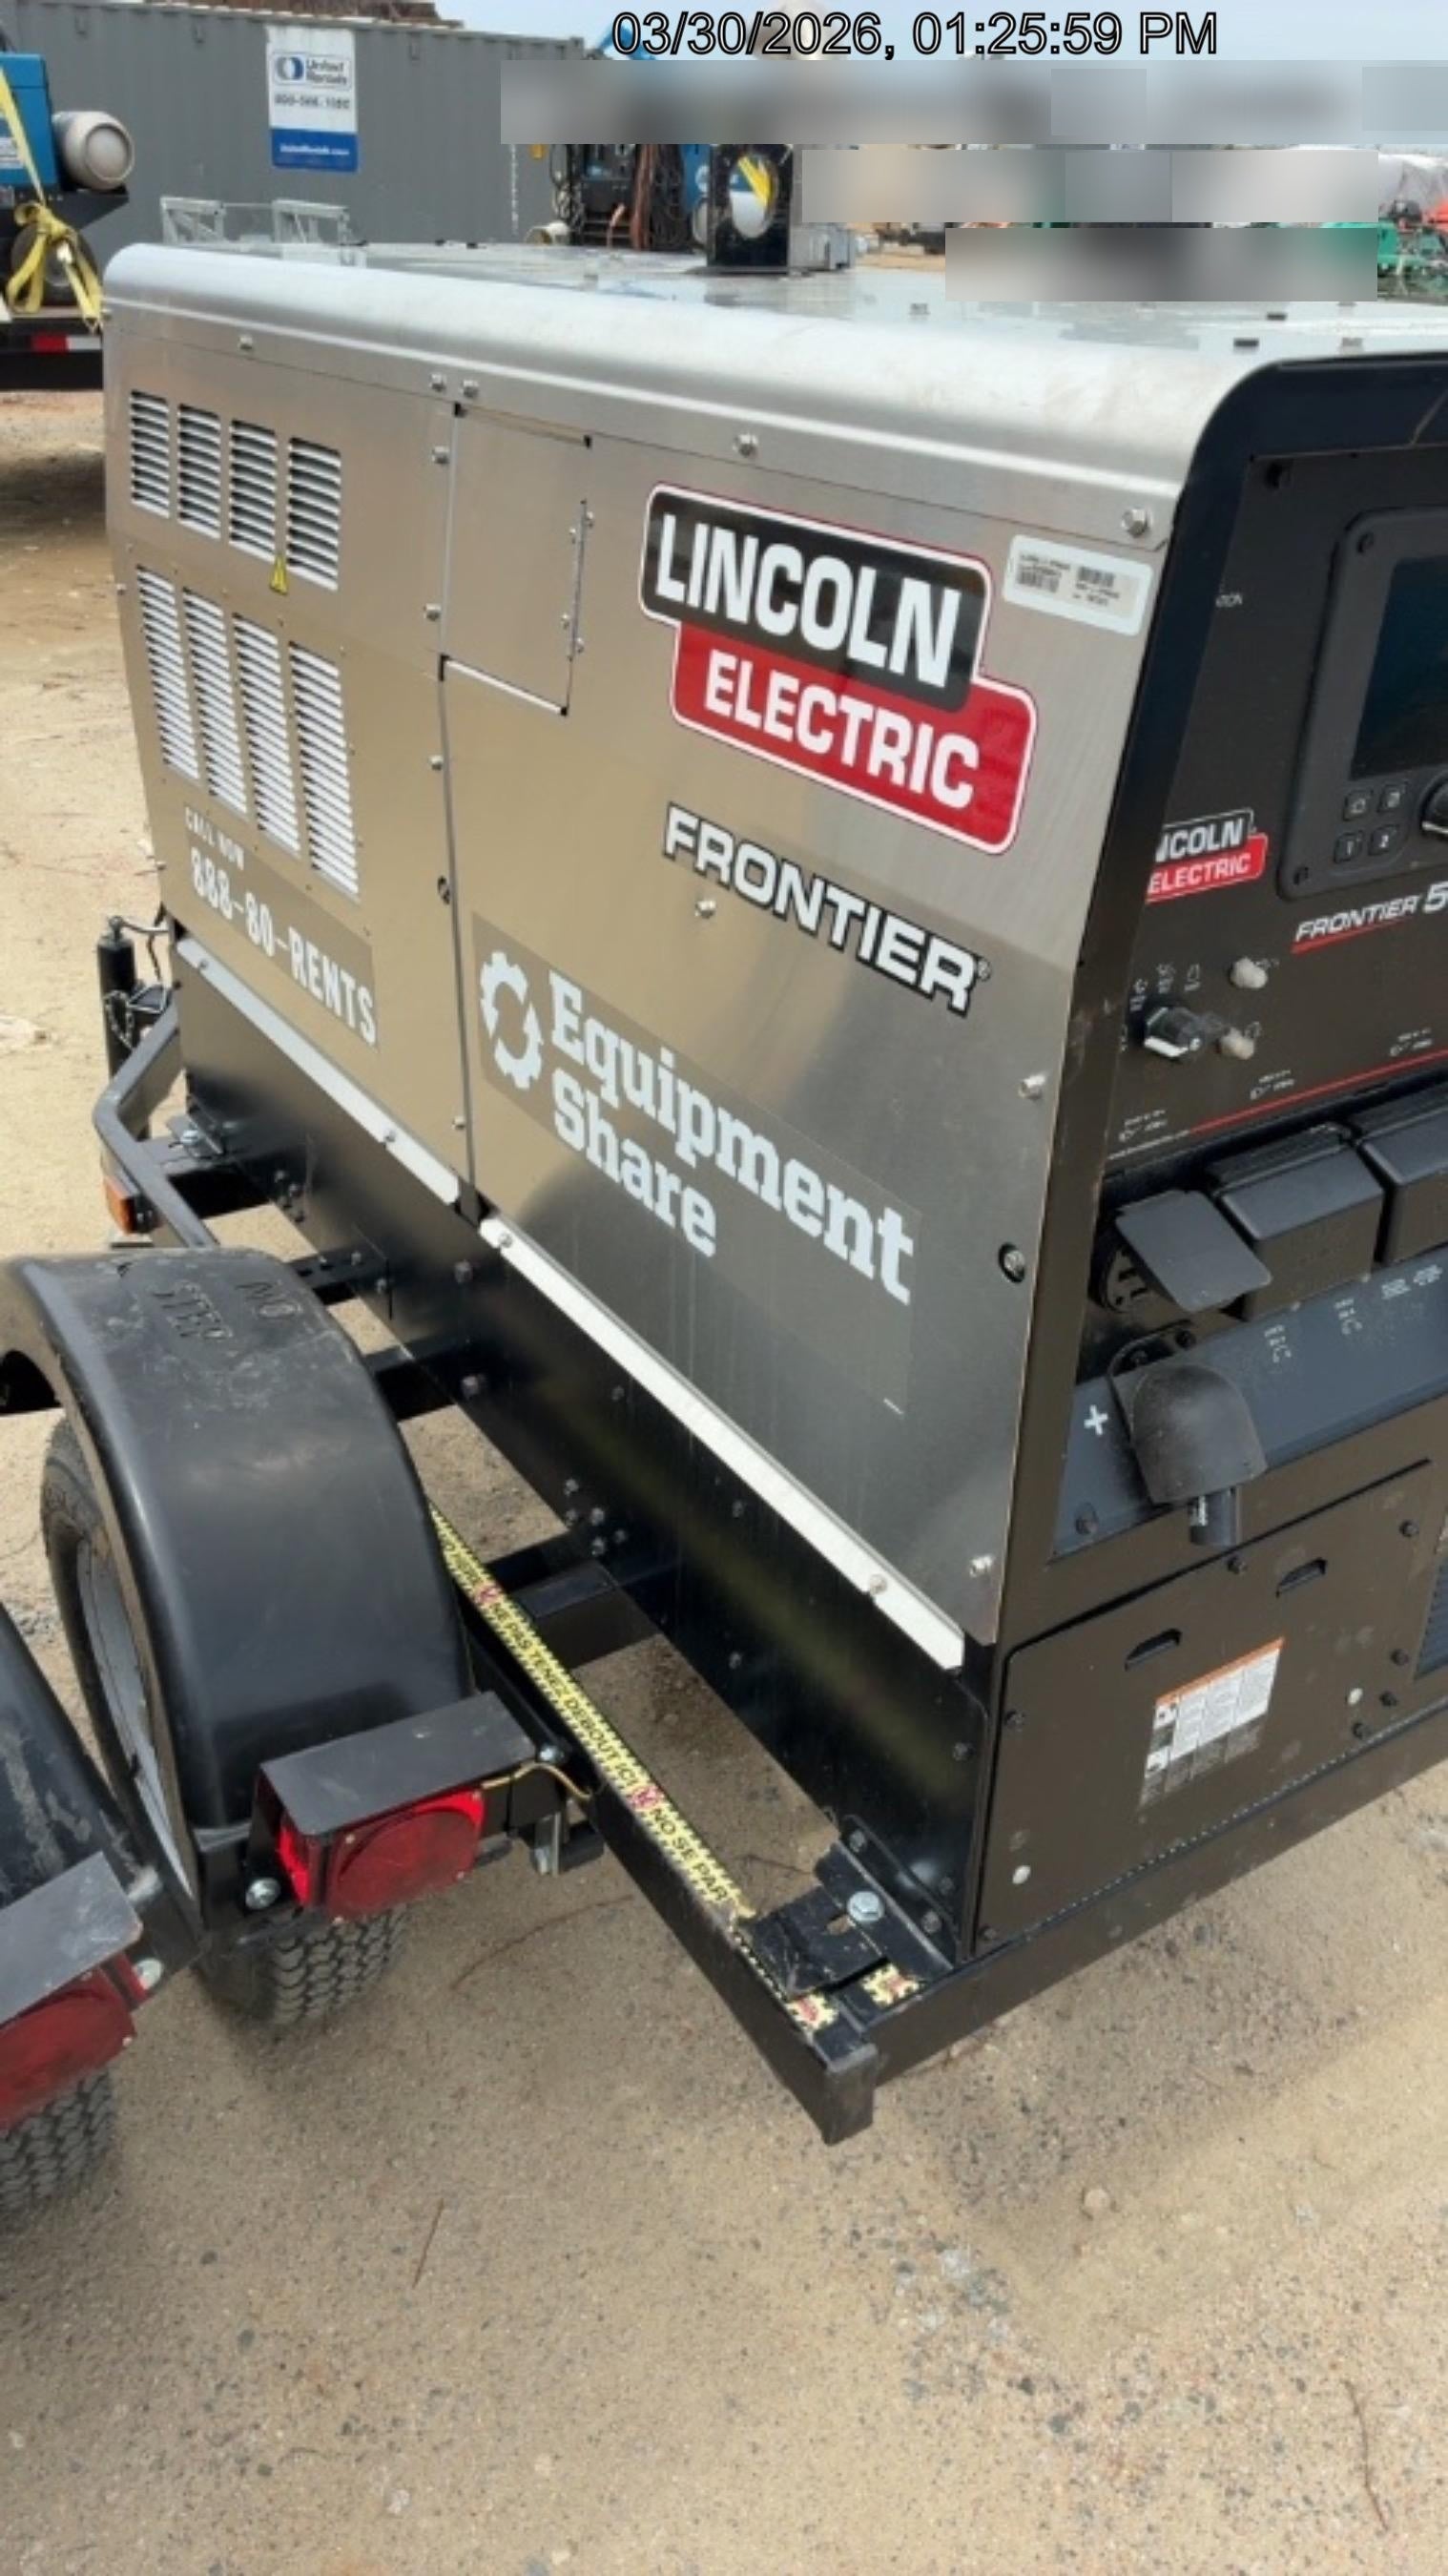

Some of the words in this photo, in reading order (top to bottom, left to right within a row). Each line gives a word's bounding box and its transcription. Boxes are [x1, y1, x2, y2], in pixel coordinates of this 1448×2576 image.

[654, 512, 962, 689] LINCOLN
[703, 648, 980, 809] ELECTRIC
[191, 845, 378, 1046] 888-80-RENTS
[1147, 852, 1252, 895] ELECTRIC
[1294, 893, 1420, 943] FRONTIER
[548, 968, 915, 1307] Equipment
[550, 1066, 716, 1257] Share
[649, 1806, 677, 1836] NO
